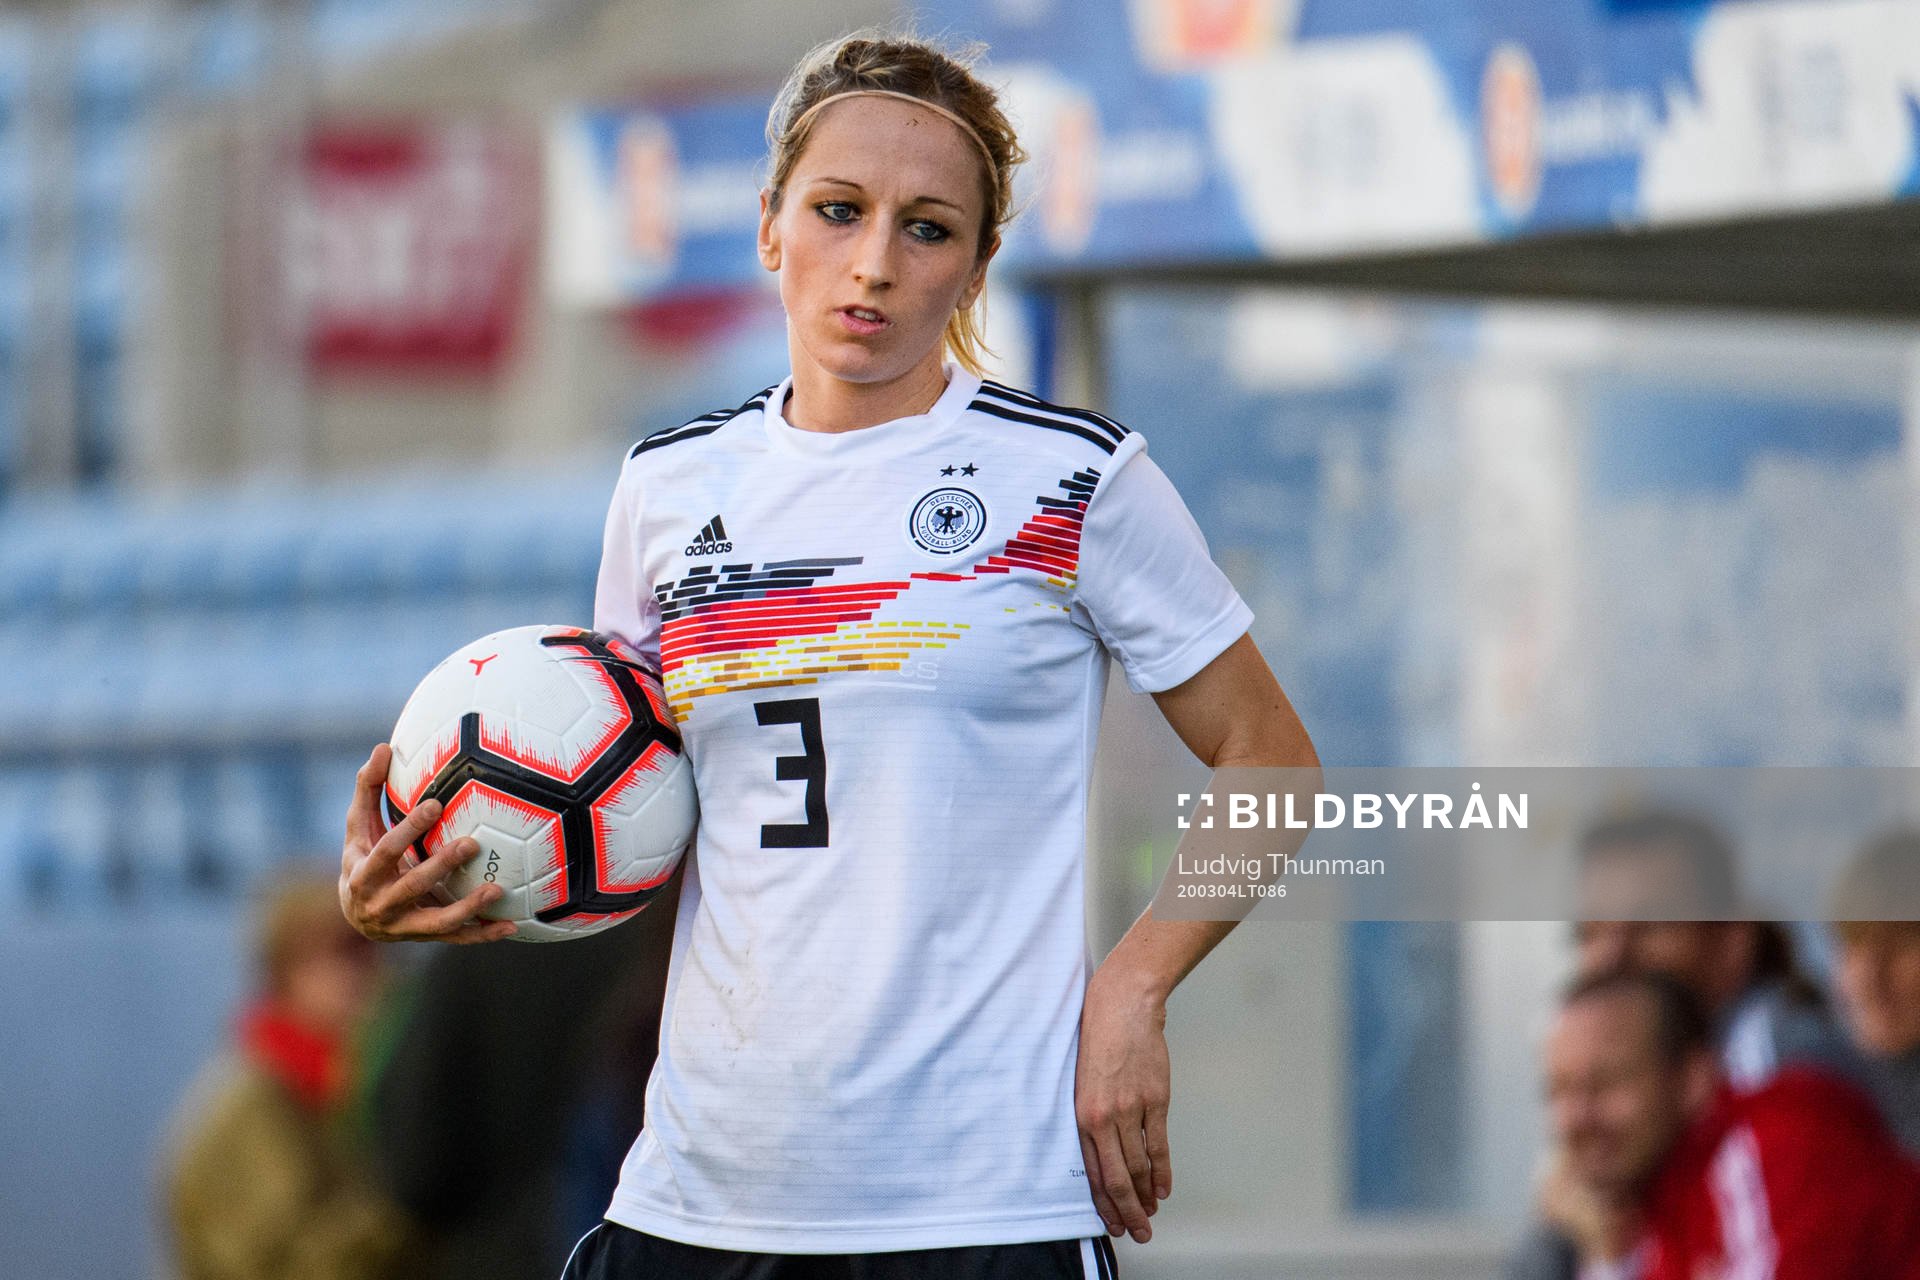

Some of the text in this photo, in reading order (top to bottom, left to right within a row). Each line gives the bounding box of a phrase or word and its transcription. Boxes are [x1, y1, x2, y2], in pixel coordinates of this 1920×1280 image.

[929, 495, 974, 511] DEUTSCHER
[684, 540, 733, 557] adidas
[753, 697, 830, 850] 3
